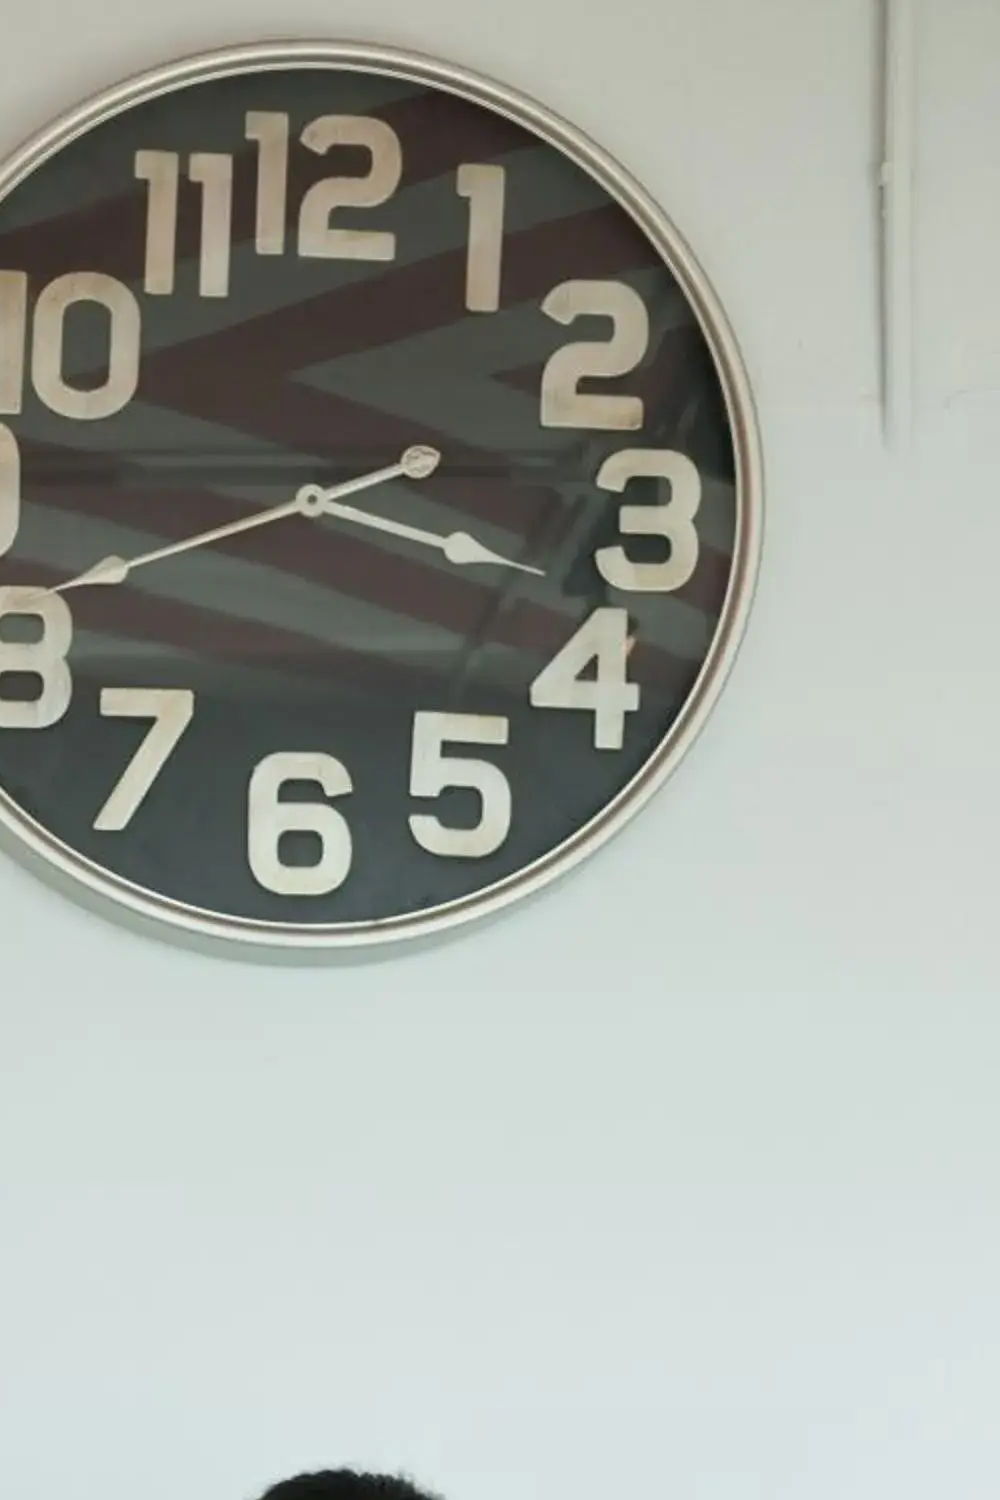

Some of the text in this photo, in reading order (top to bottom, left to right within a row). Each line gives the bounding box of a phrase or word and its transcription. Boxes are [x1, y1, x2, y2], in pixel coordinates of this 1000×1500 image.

[134, 149, 233, 298] 11
[245, 110, 402, 261] 12
[456, 163, 506, 312] 1
[539, 279, 650, 431] 2
[594, 448, 702, 592] 3
[529, 607, 641, 750] 4
[92, 686, 195, 832] 7
[247, 750, 354, 896] 6
[408, 710, 512, 858] 5
